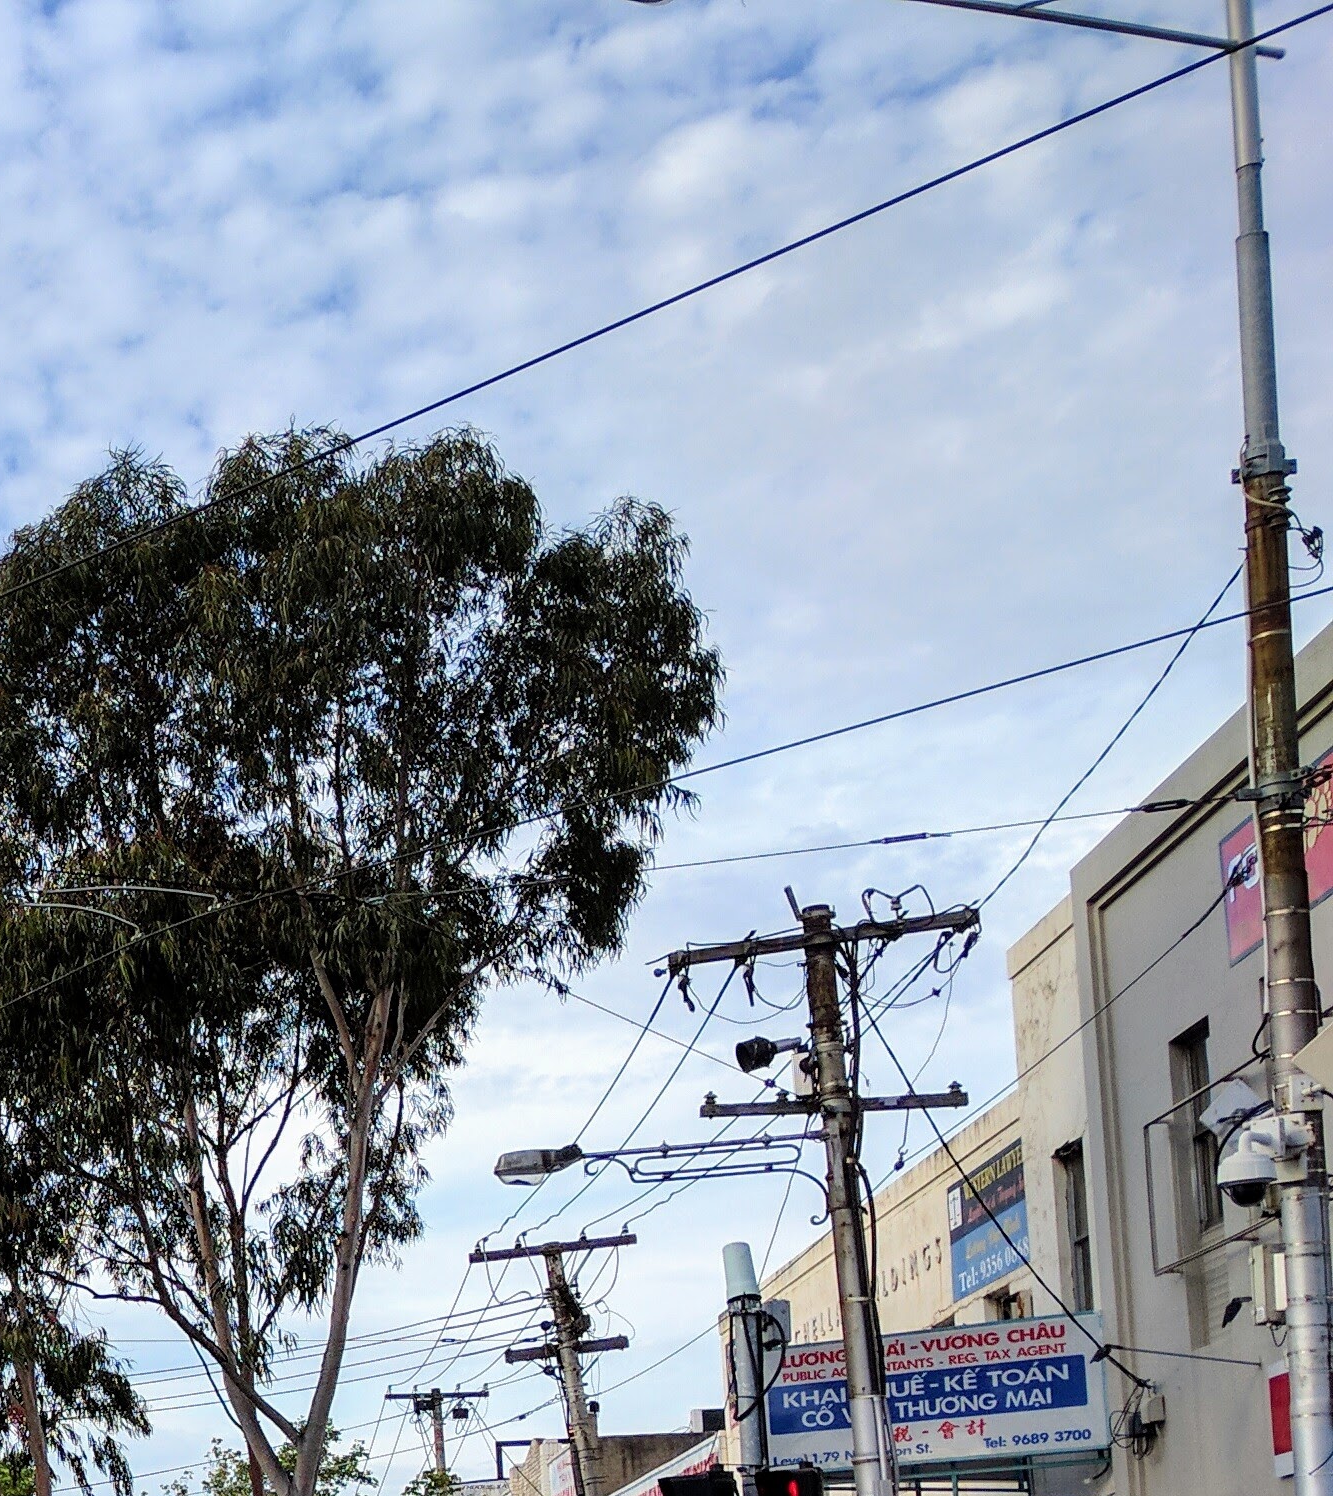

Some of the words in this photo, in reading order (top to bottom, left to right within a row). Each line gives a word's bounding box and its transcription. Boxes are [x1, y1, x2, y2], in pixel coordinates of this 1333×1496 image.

[1007, 1323, 1066, 1343] CHÂU
[782, 1368, 826, 1382] PUBLIC
[983, 1348, 1010, 1361] TAX
[1016, 1343, 1067, 1357] AGENT
[986, 1360, 1069, 1387] TOÁN
[895, 1393, 998, 1419] THƯƠNG
[1005, 1386, 1052, 1410] MẠI
[983, 1436, 1008, 1449] Tel:
[1012, 1432, 1049, 1447] 9689
[1055, 1429, 1092, 1443] 3700
